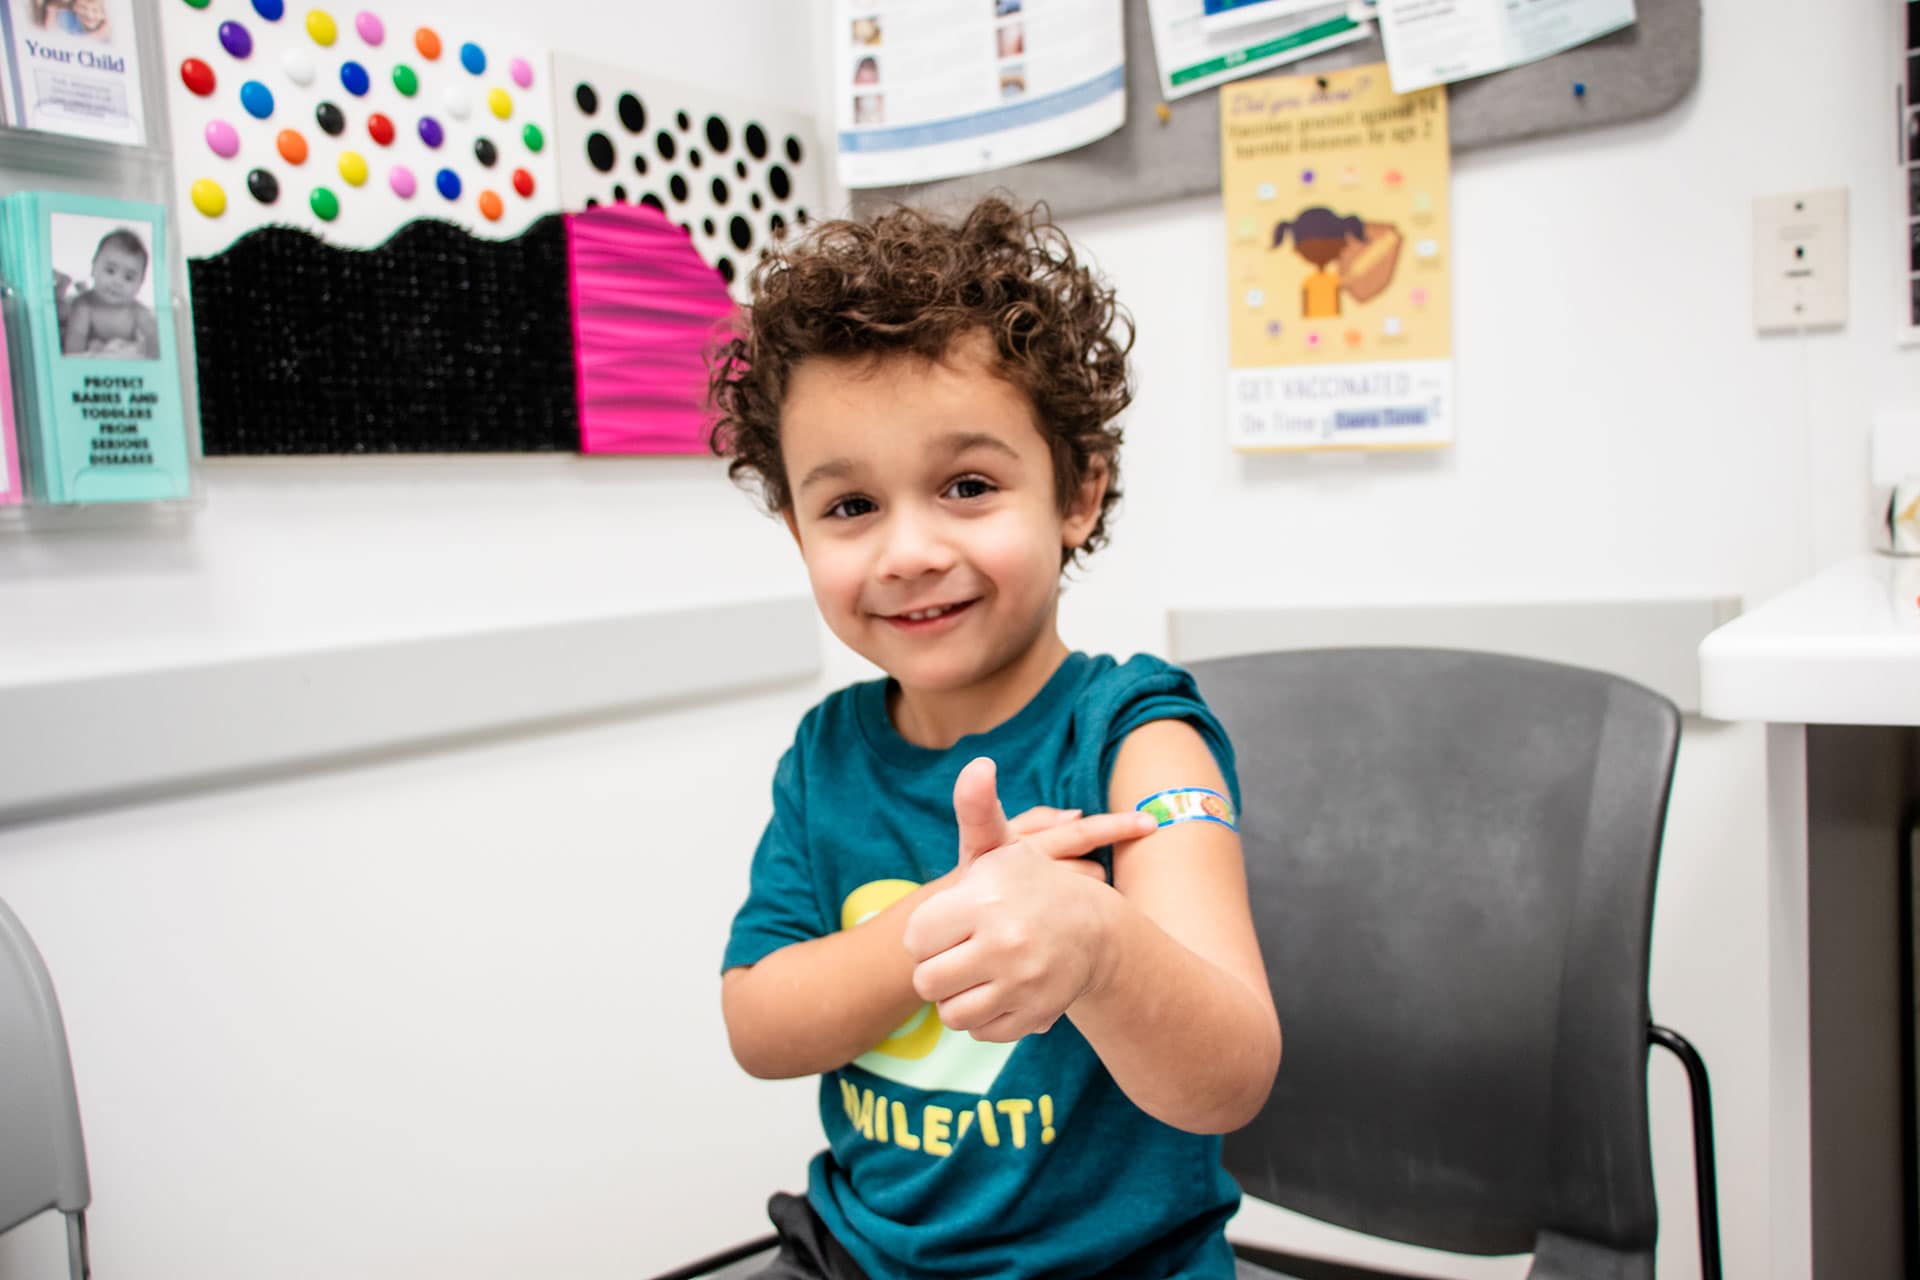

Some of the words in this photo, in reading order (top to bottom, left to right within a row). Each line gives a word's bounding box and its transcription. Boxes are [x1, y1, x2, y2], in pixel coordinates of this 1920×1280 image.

[25, 39, 72, 63] Your
[78, 50, 125, 73] Child
[1299, 111, 1354, 133] protect
[83, 376, 144, 389] PROTECT
[1237, 377, 1274, 402] GET
[1280, 370, 1412, 397] VACCINATED
[72, 391, 122, 404] BABIES
[128, 391, 158, 404] AND
[81, 407, 153, 420] TODDLERS
[100, 423, 139, 434] FROM
[90, 437, 149, 450] SERIOUS
[89, 453, 154, 466] DISEASES
[977, 1094, 1056, 1150] IT!
